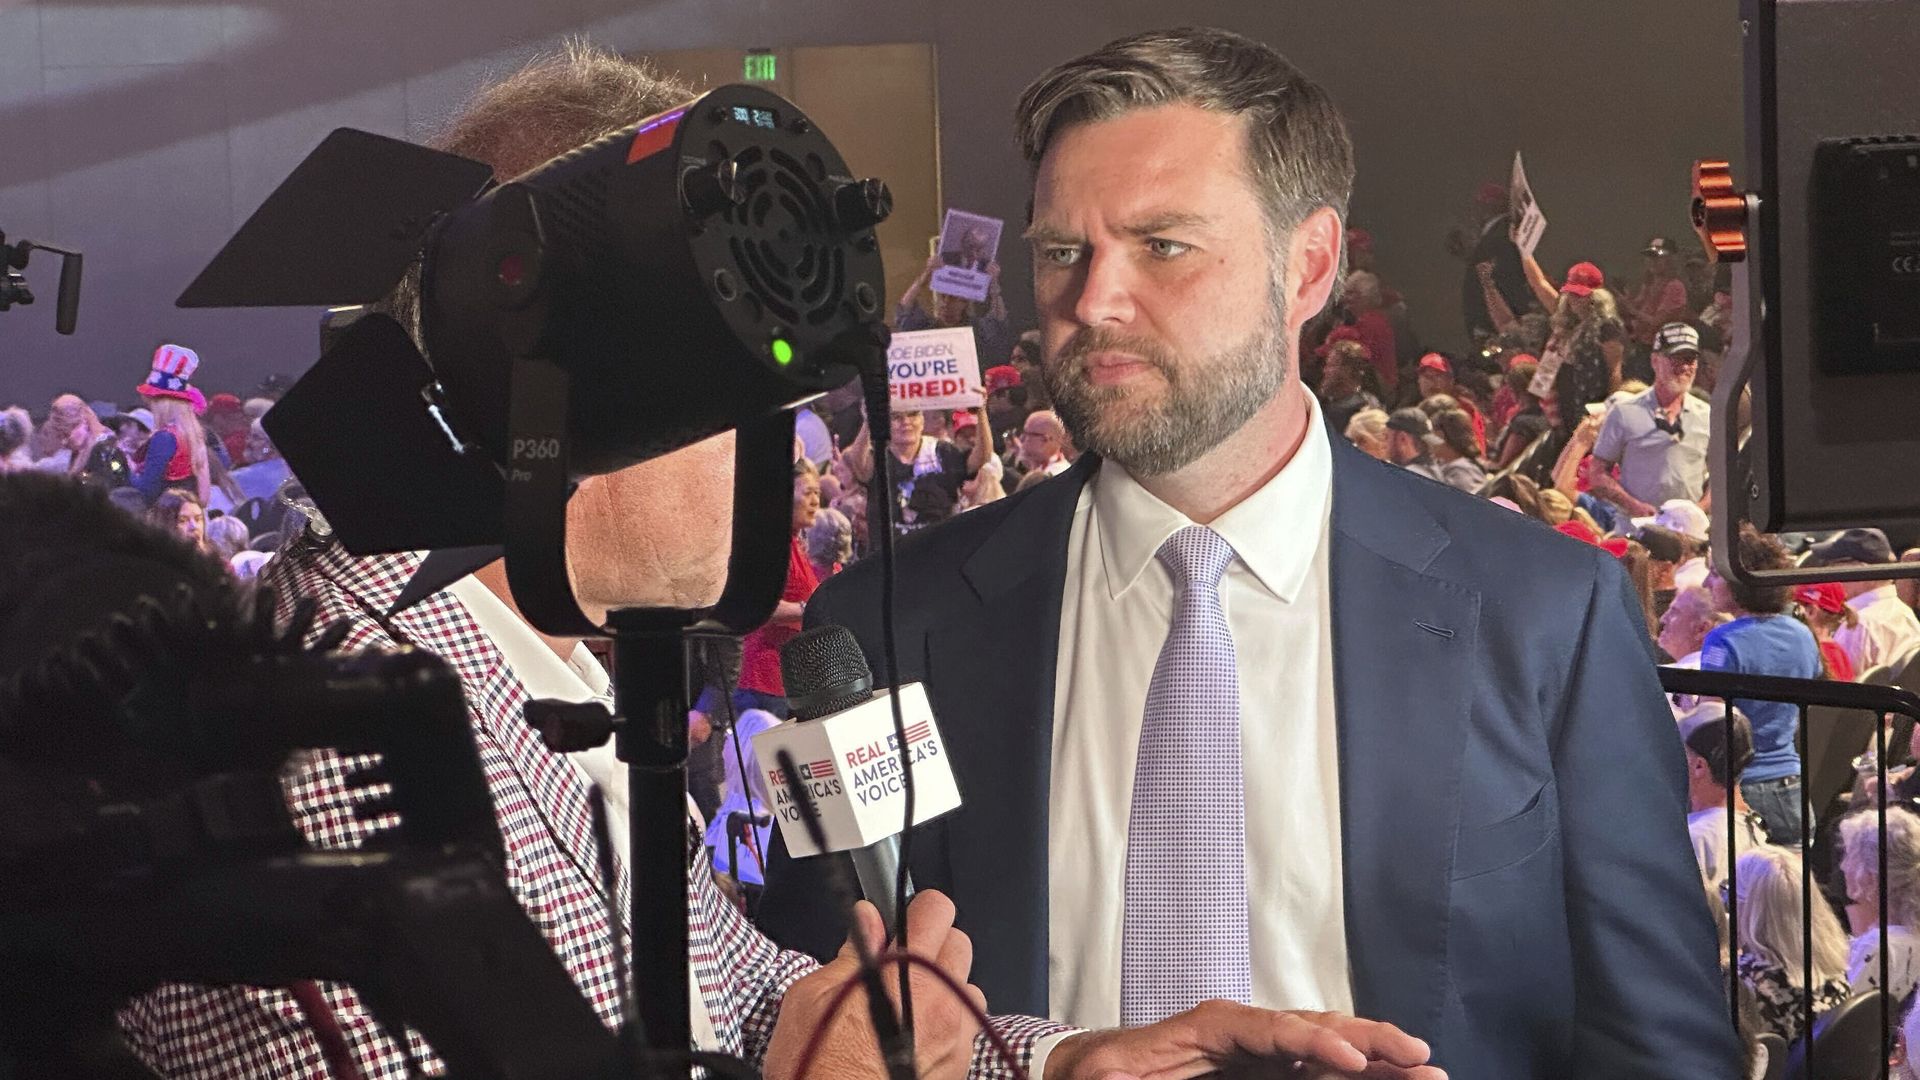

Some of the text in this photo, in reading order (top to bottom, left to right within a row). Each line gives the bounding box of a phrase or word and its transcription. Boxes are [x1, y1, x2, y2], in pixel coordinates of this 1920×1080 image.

[744, 54, 776, 81] EXIT
[887, 358, 958, 379] YOU'RE
[513, 439, 560, 460] P360
[846, 741, 885, 768] REAL
[768, 766, 791, 786] RE
[776, 779, 842, 805] AMICA'S
[779, 801, 822, 823] VOE
